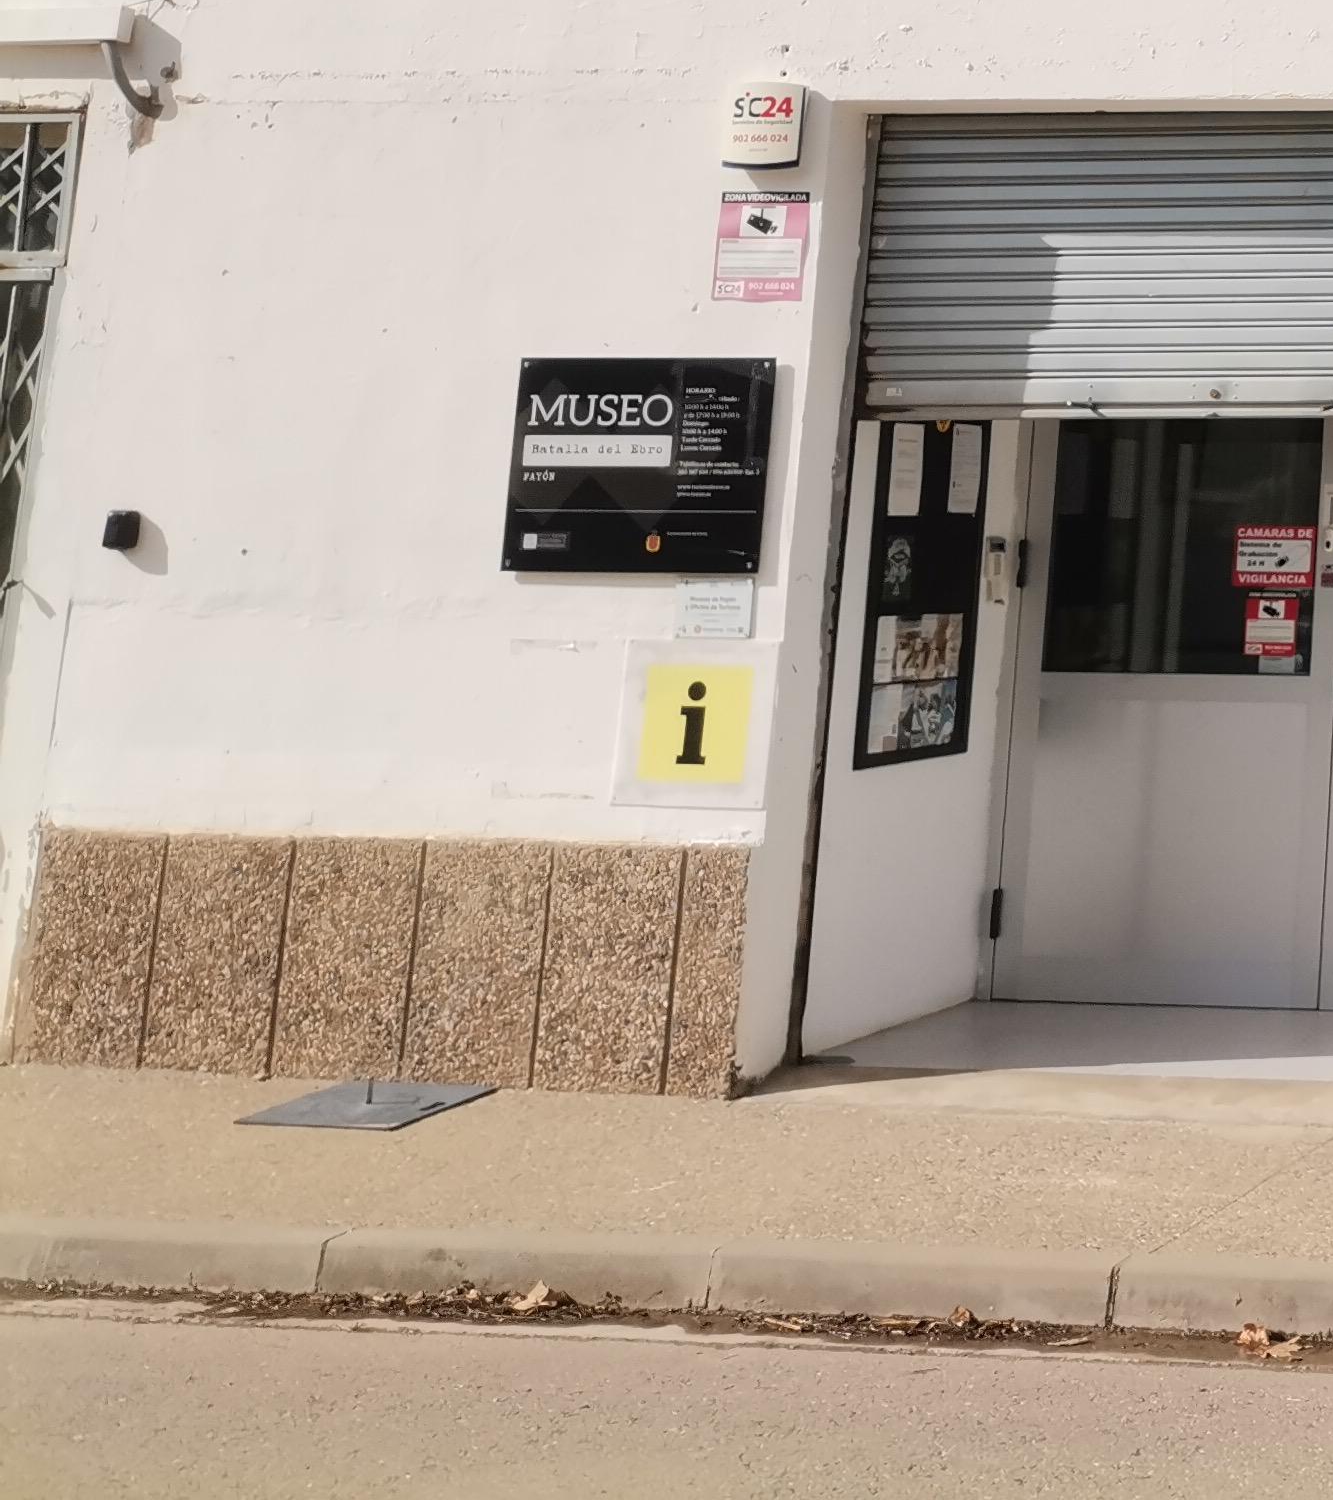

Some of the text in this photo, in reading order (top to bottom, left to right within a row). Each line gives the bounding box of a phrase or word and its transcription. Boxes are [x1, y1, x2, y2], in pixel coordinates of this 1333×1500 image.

[733, 94, 793, 118] SC24
[733, 134, 789, 143] 902 666 024
[724, 193, 807, 202] ZONA VIDEOVIGILADA
[717, 283, 741, 294] SC24
[749, 282, 763, 290] 902
[781, 282, 795, 291] 024
[527, 393, 674, 427] MUSEO
[531, 444, 663, 454] Batalla del Ebro
[522, 469, 556, 482] FAYÓN
[1238, 527, 1314, 539] CAMARAS DE
[675, 680, 708, 766] i
